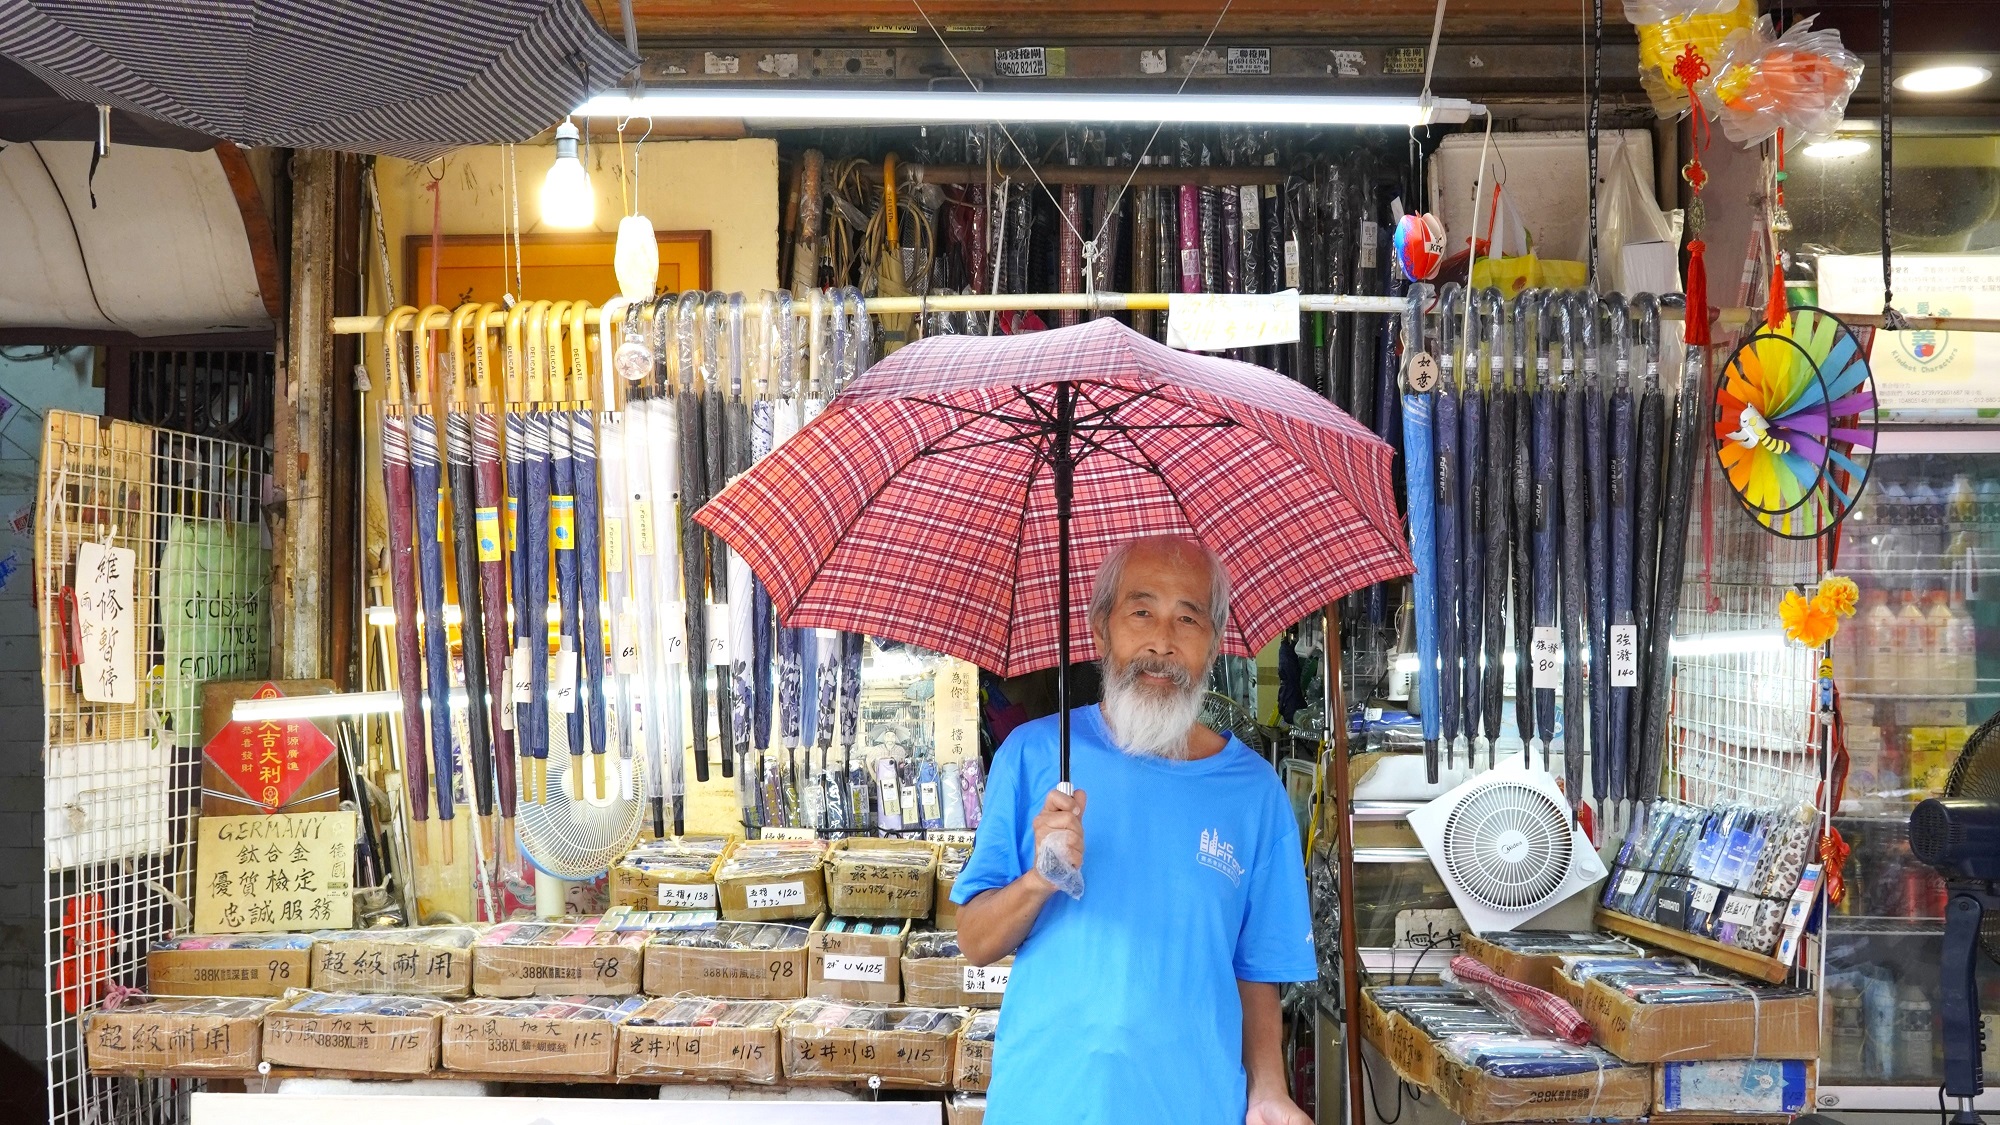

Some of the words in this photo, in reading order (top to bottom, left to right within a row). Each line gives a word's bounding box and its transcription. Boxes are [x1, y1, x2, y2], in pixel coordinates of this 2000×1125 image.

[1002, 61, 1019, 74] 9602
[1020, 60, 1037, 74] 8212
[549, 345, 557, 378] DELICATE
[573, 348, 583, 381] DELICATE
[1416, 357, 1431, 387] 如意
[96, 553, 124, 699] 維修暫停
[622, 646, 634, 657] 65
[668, 636, 681, 652] 70
[711, 638, 725, 655] 75
[1539, 659, 1554, 672] 80
[516, 681, 531, 691] 45
[557, 687, 571, 699] 45
[241, 726, 254, 773] 恭喜發財
[287, 724, 300, 771] 財源廣進
[218, 815, 327, 841] GERMANY
[236, 841, 310, 865] 鈦合金
[1218, 841, 1234, 854] JC
[329, 842, 346, 879] 德國
[208, 868, 318, 899] 優質檢定
[619, 873, 649, 888] 特大
[219, 898, 335, 928] 忠誠服務
[1658, 898, 1680, 912] SHIMANO
[268, 960, 290, 981] 98
[320, 949, 453, 979] 超級耐用
[593, 957, 619, 980] 98
[769, 961, 794, 982] 98
[98, 1022, 231, 1054] 超級耐用
[332, 1019, 377, 1034] 加大
[391, 1035, 420, 1051] 115
[487, 1038, 520, 1052] 338XL
[574, 1032, 603, 1049] 115
